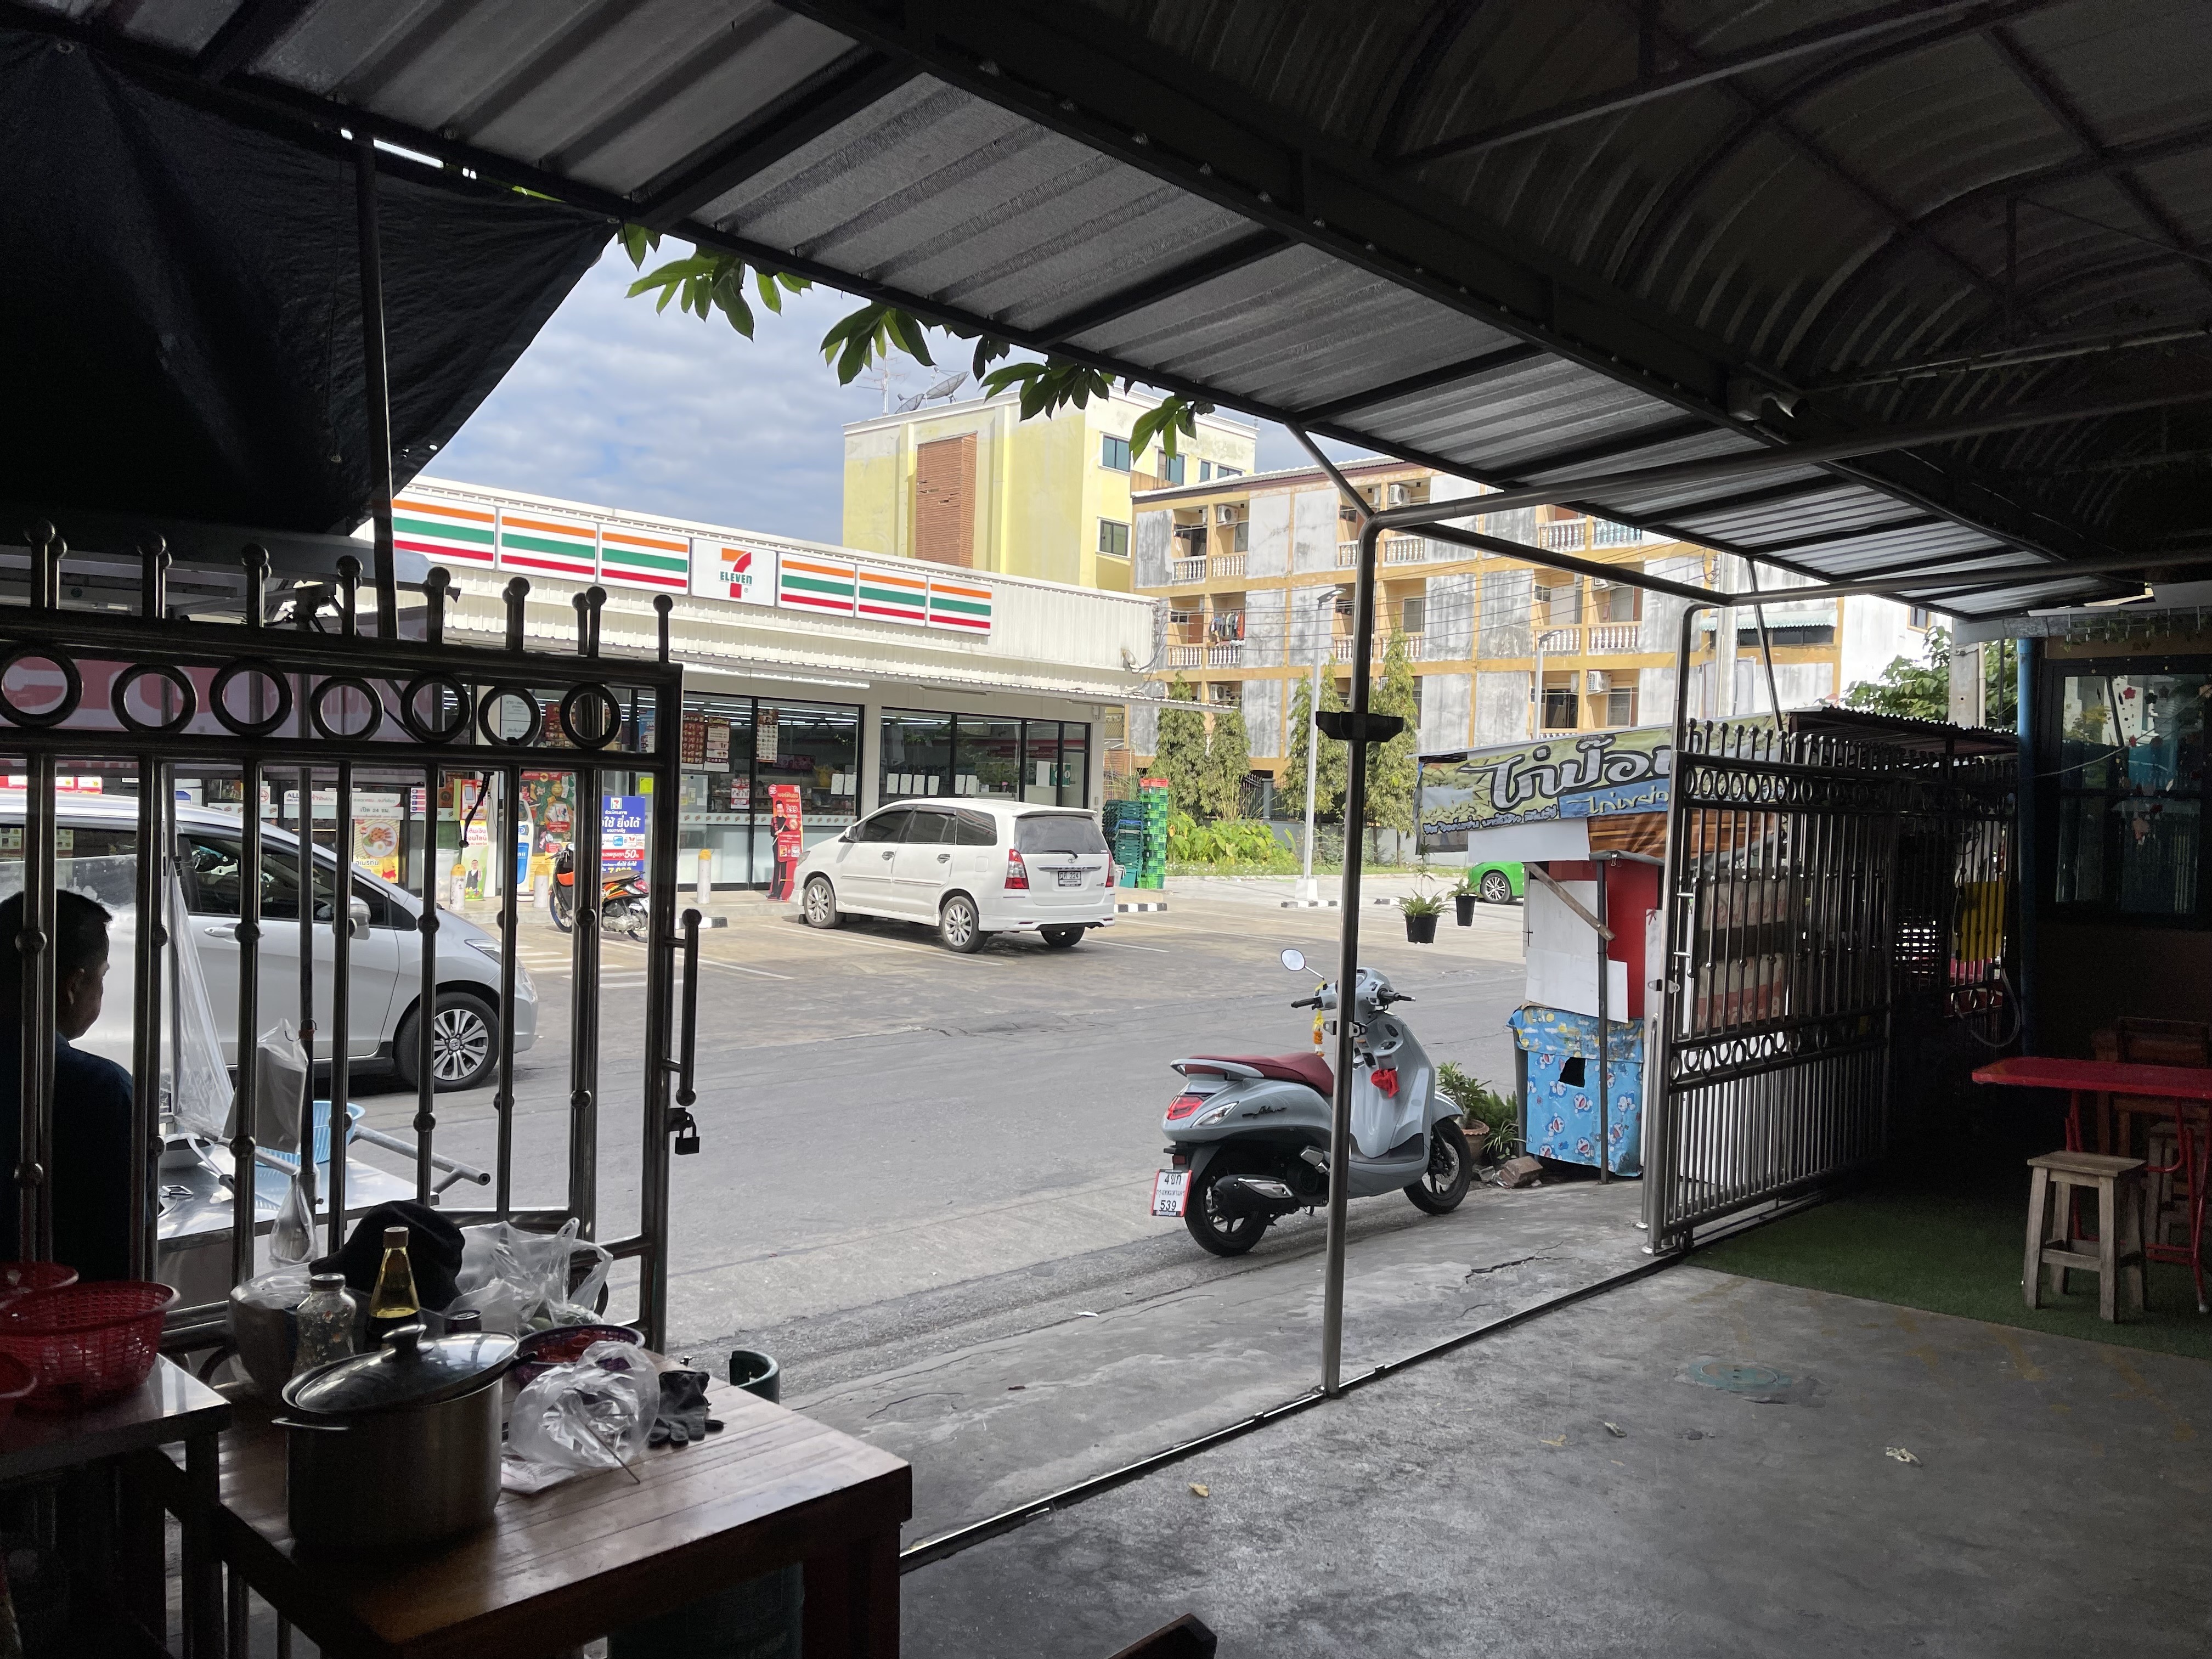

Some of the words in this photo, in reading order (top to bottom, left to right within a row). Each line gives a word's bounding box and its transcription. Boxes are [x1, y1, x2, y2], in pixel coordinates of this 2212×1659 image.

[720, 571, 752, 585] ELEVEN
[721, 548, 752, 598] 7
[617, 815, 641, 828] ยิ่งได้
[1160, 1200, 1177, 1210] 539
